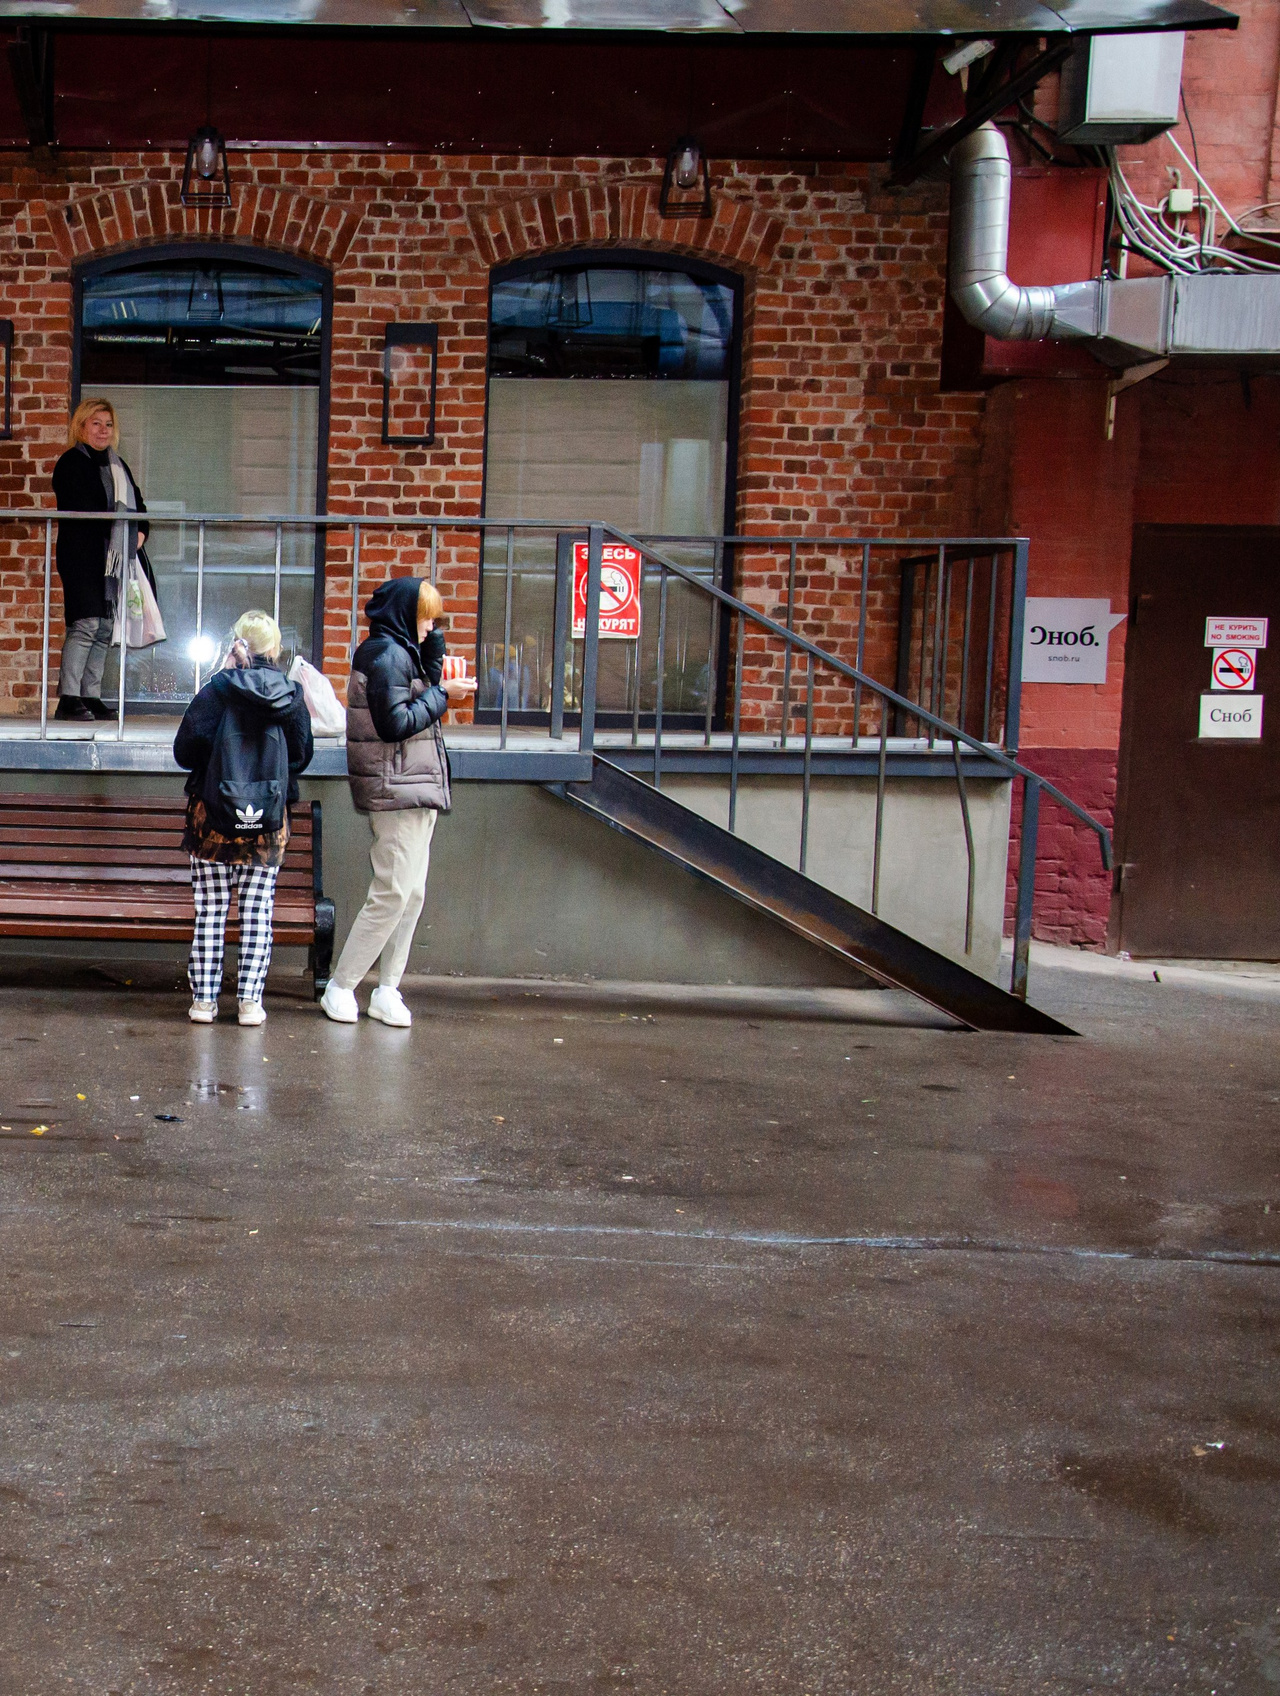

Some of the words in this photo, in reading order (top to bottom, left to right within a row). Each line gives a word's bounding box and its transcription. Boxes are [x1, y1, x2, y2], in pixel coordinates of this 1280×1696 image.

[581, 547, 636, 560] ЗЕСЬ
[1228, 624, 1258, 632] КУРИТЬ
[1225, 633, 1261, 641] SMOKING
[1210, 708, 1252, 723] Сноб
